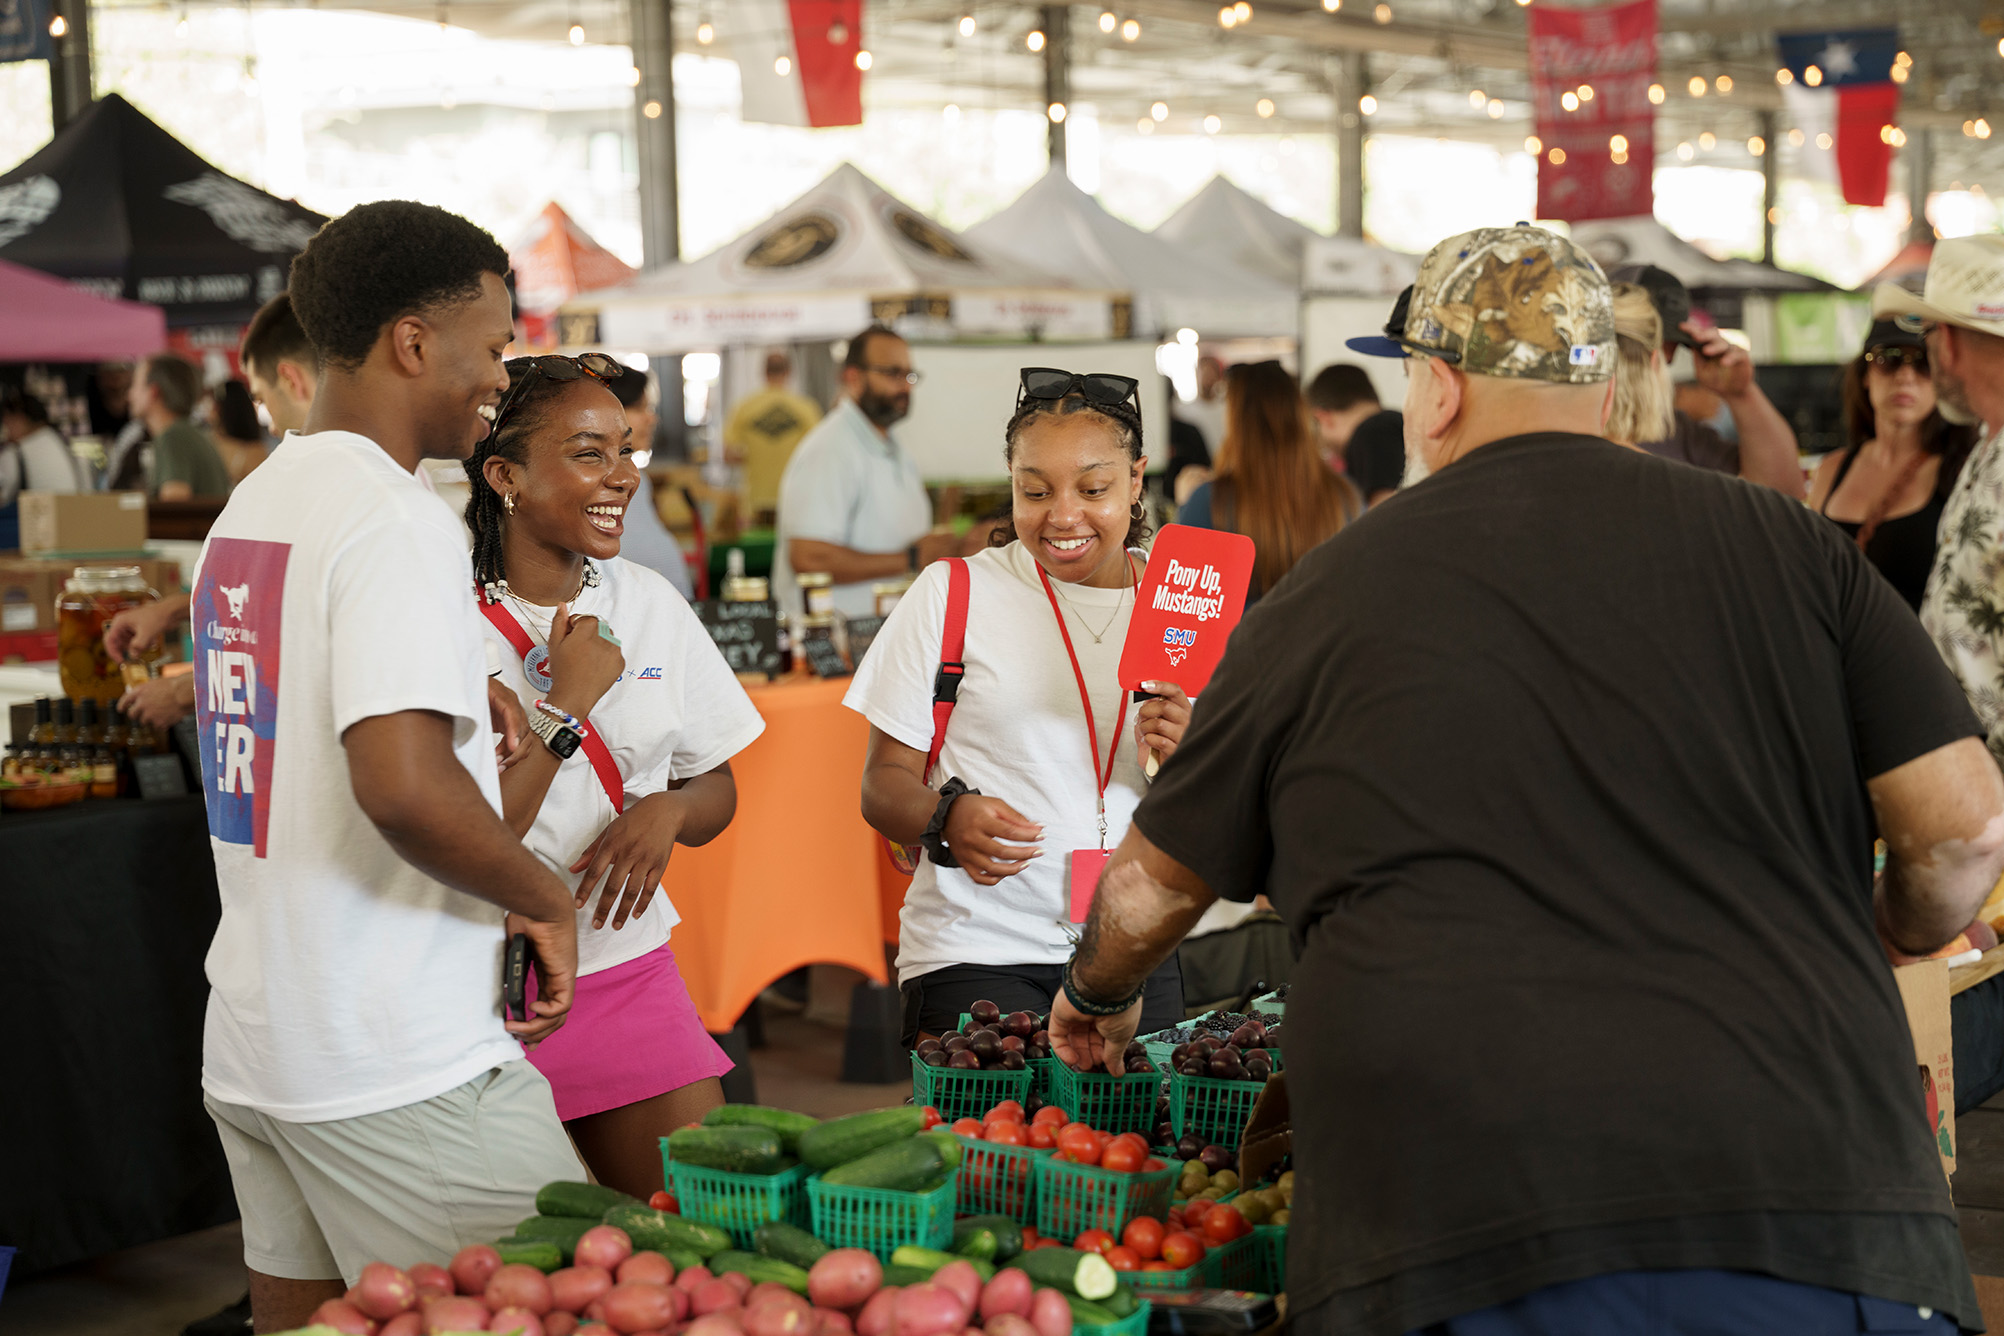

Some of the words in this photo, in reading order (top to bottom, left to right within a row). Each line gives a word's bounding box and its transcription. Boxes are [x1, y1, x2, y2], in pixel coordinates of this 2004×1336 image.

[1164, 559, 1201, 592] Pony
[1200, 564, 1222, 595] Up,
[1152, 584, 1225, 622] Mustangs!
[1163, 627, 1197, 647] SMU
[640, 667, 663, 678] ACC
